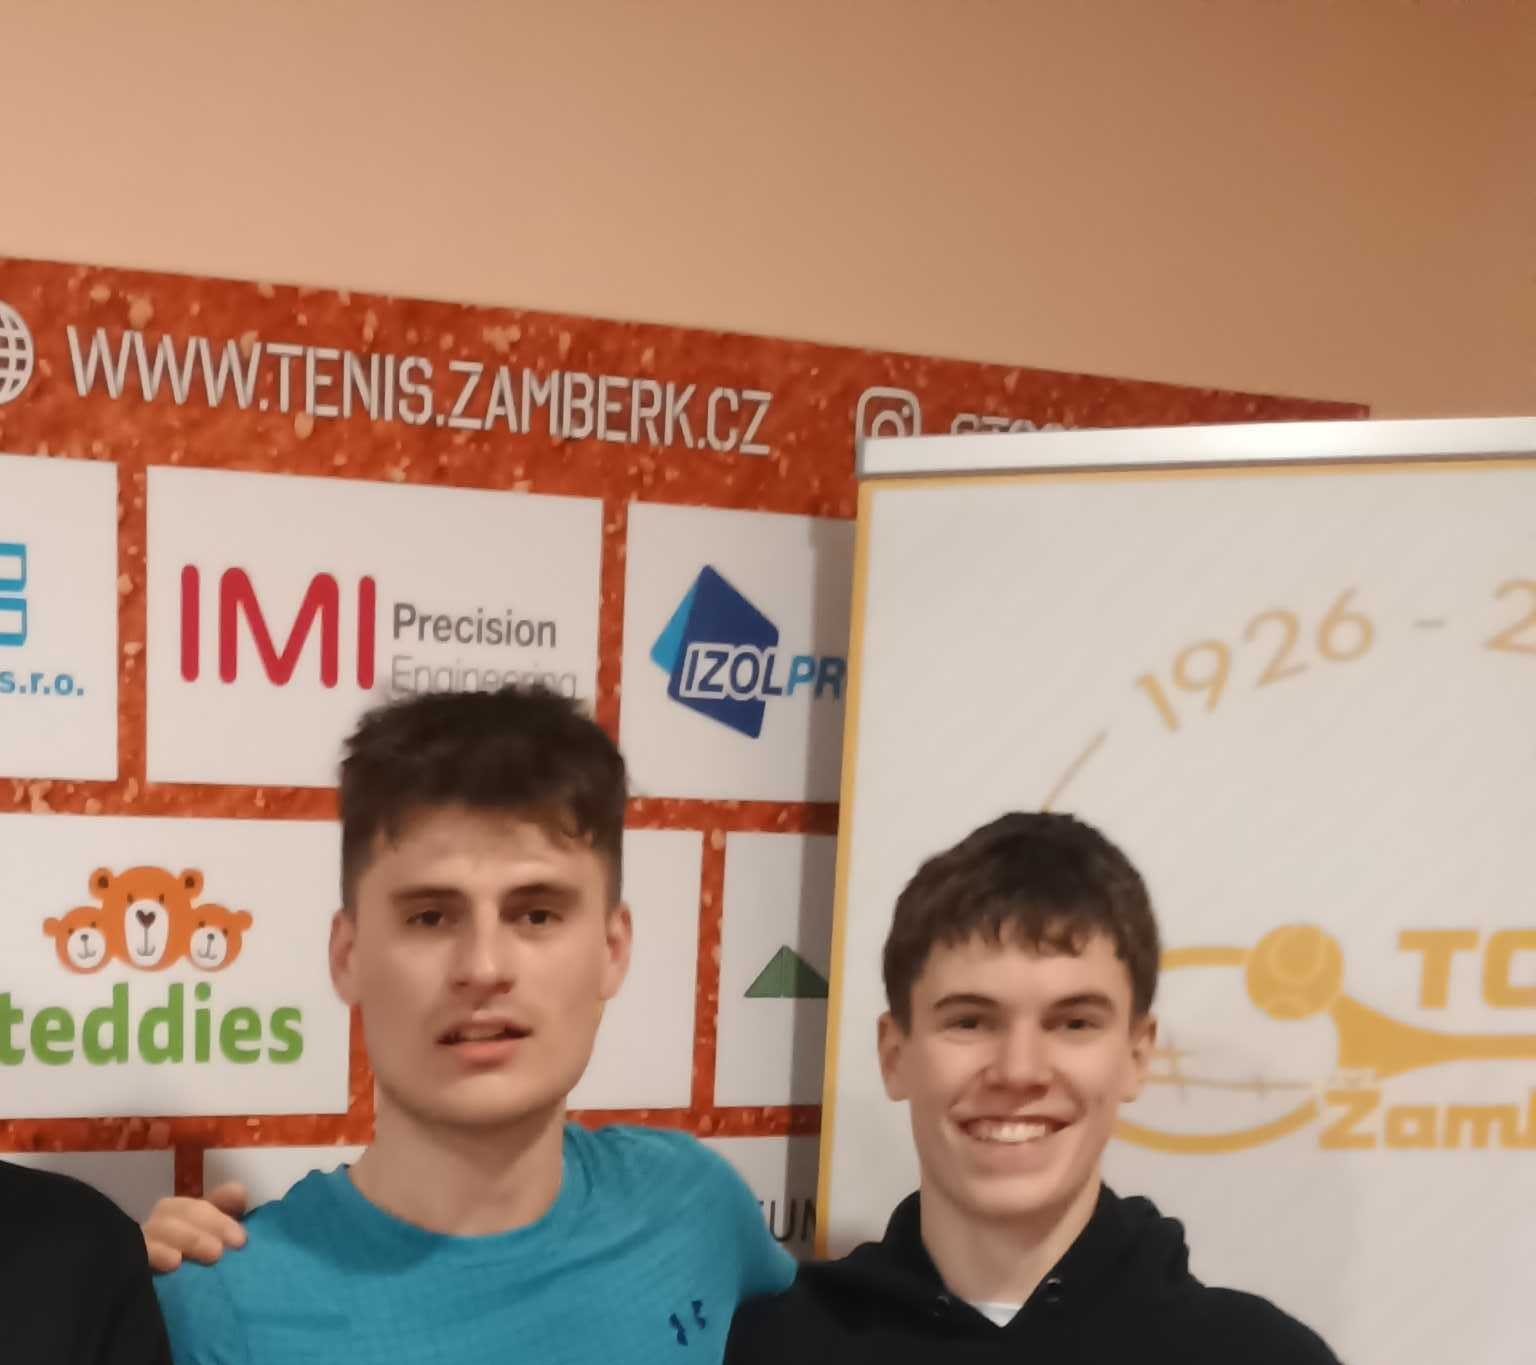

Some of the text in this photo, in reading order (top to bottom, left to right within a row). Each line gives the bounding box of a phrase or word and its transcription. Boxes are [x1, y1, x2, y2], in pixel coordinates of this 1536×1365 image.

[66, 325, 773, 456] WWW.TENIS.ZAMBERK.CZ
[180, 563, 377, 691] IMI
[392, 602, 557, 648] Precision
[1134, 585, 1376, 733] 1926
